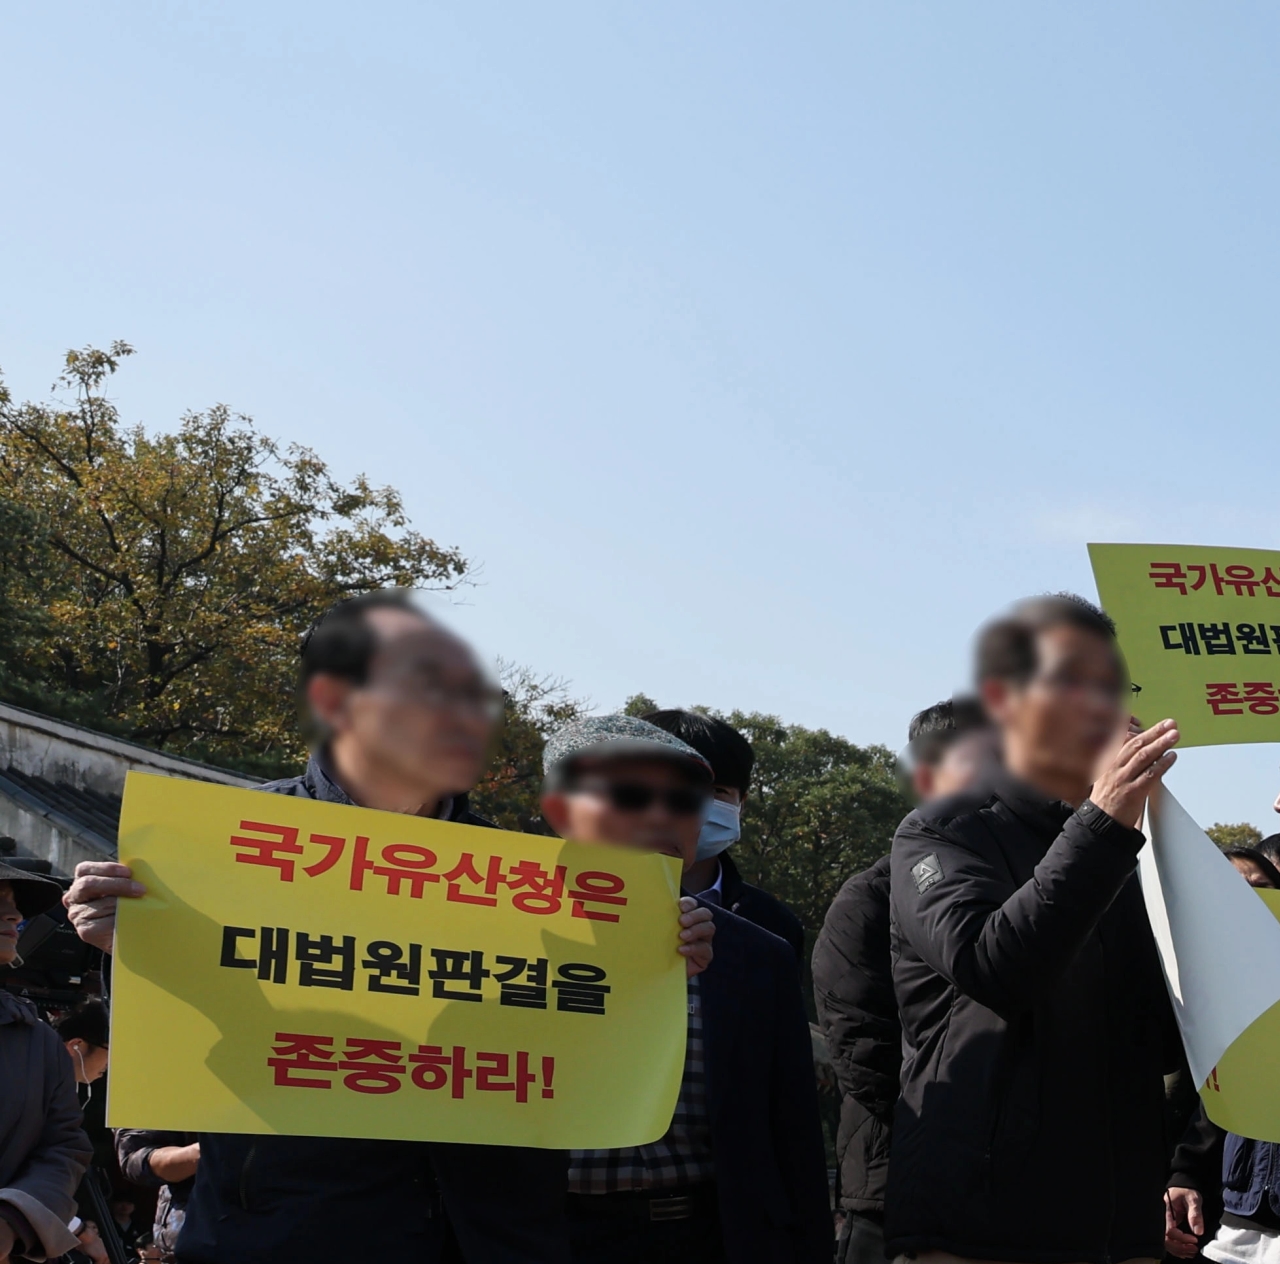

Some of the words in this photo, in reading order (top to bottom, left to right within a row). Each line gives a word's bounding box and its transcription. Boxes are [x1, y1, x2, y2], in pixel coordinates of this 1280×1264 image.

[230, 820, 627, 923] 국가유산청은
[219, 925, 611, 1016] 대법원판결을
[267, 1032, 555, 1103] 존중하라!
